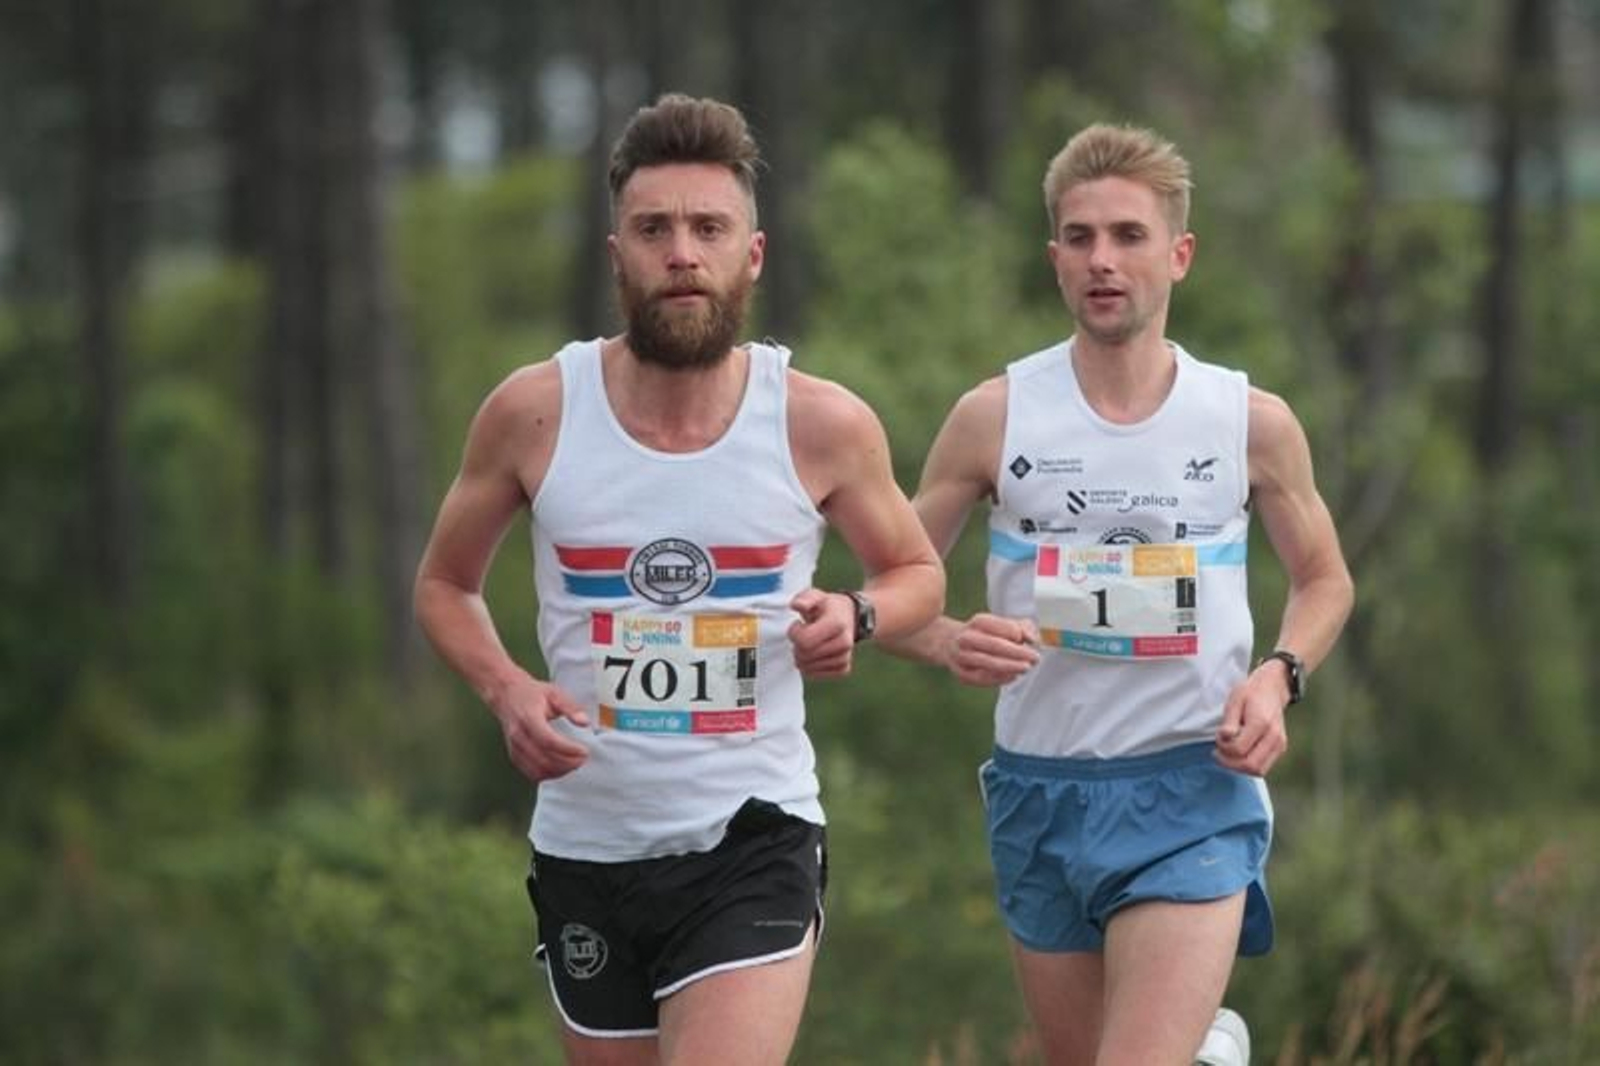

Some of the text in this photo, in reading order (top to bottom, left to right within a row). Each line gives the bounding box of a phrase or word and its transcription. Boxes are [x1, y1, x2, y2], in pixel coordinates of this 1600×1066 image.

[1117, 491, 1179, 513] galicia
[1090, 588, 1113, 629] 1
[604, 655, 713, 702] 701
[625, 716, 665, 730] unicef
